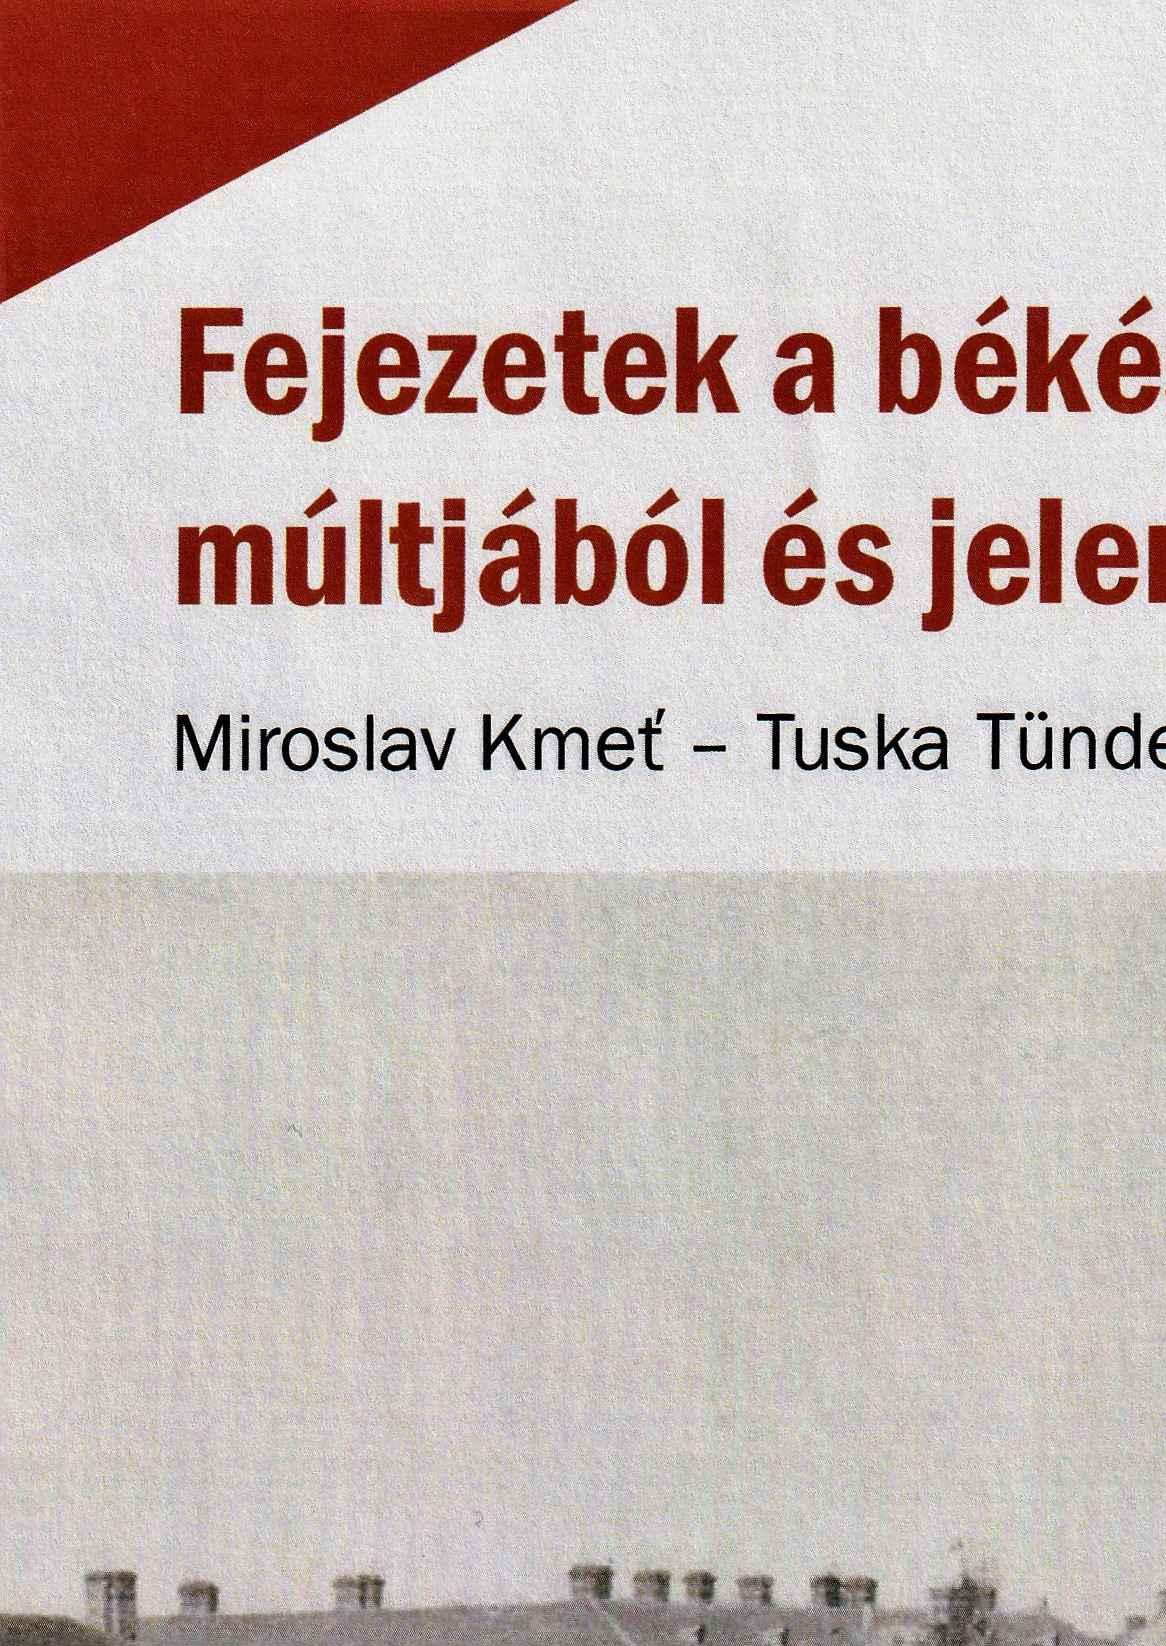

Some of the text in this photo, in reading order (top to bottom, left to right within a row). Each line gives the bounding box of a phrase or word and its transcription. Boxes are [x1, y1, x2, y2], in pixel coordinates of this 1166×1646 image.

[180, 307, 740, 442] Fejezetek
[773, 333, 835, 415] a
[178, 488, 725, 633] múltjából
[763, 488, 894, 606] és
[176, 714, 456, 772] Miroslav
[483, 708, 665, 771] Kmeť
[757, 713, 948, 771] Tuska
